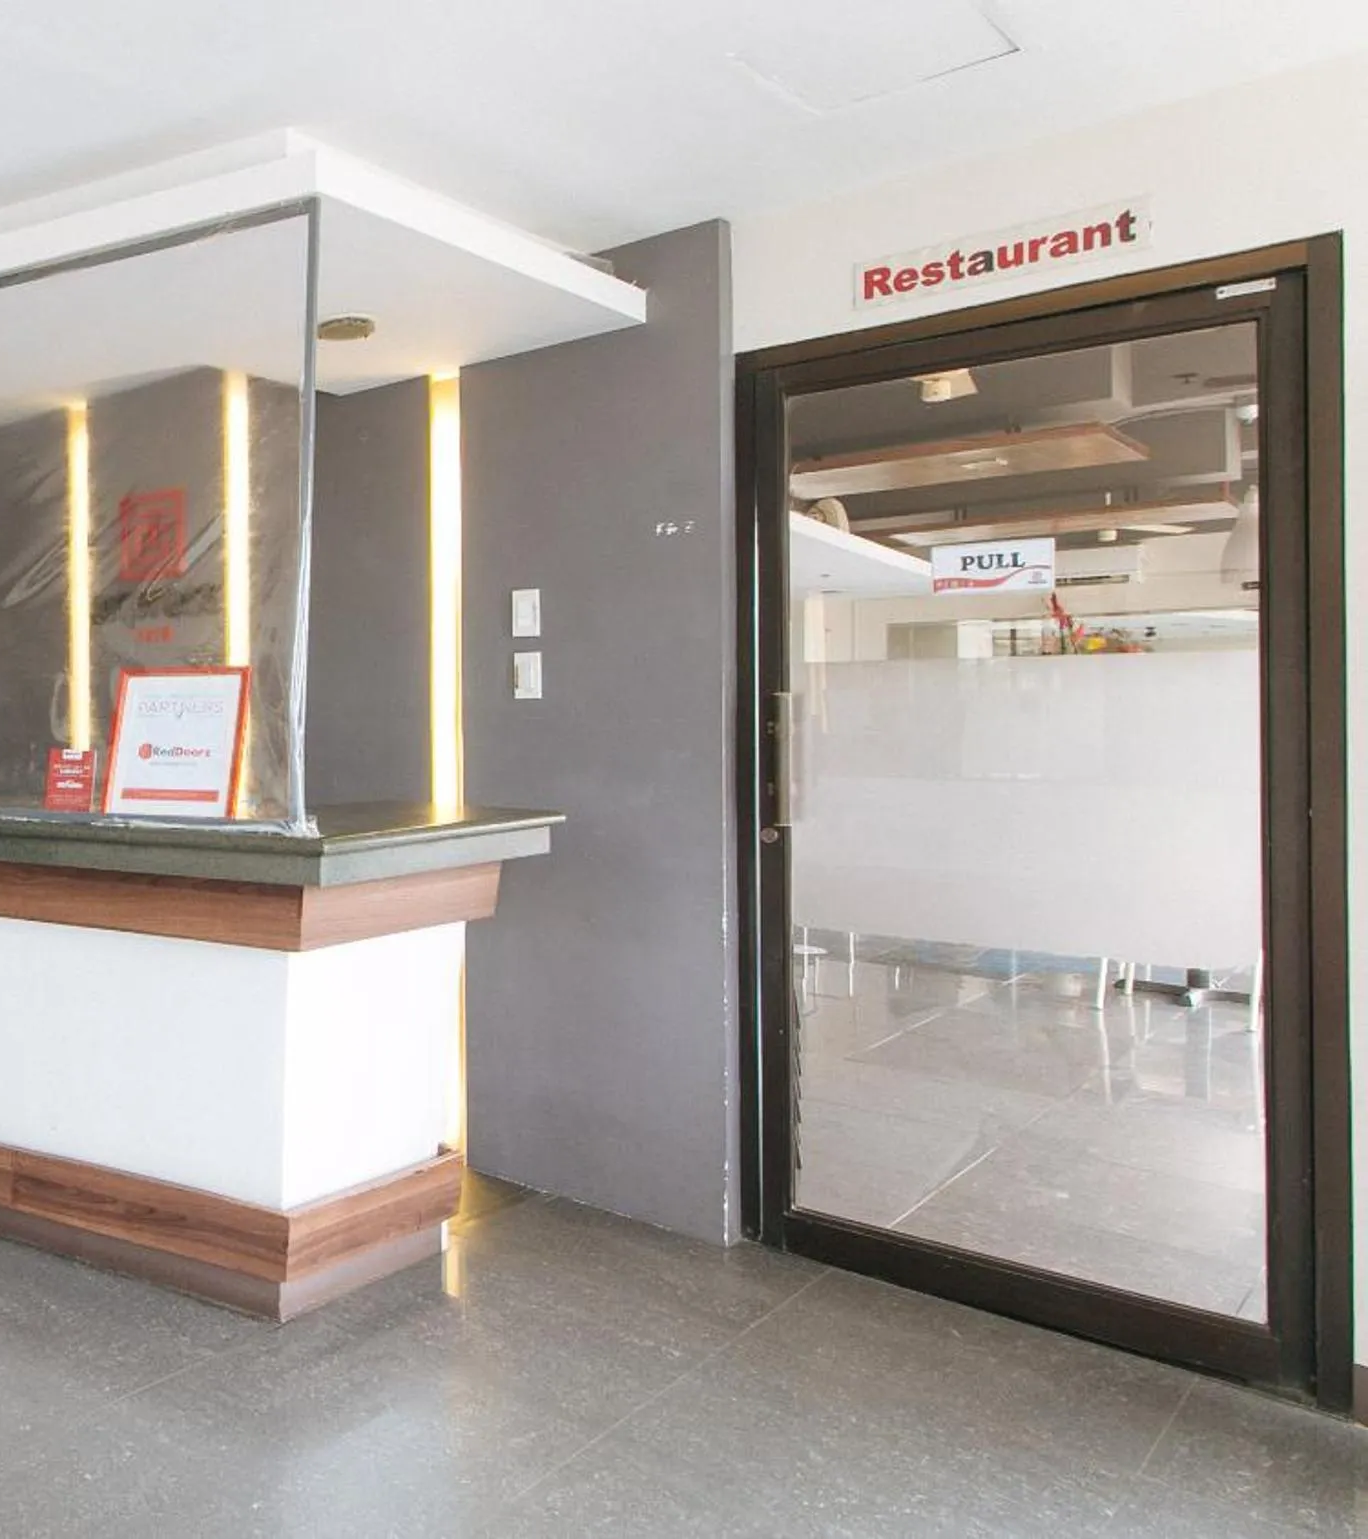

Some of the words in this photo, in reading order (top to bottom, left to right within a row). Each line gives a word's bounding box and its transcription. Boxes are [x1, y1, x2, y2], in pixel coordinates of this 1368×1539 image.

[862, 208, 1137, 301] Restaurant
[960, 552, 1026, 571] PULL
[152, 746, 211, 759] RedDoorz
